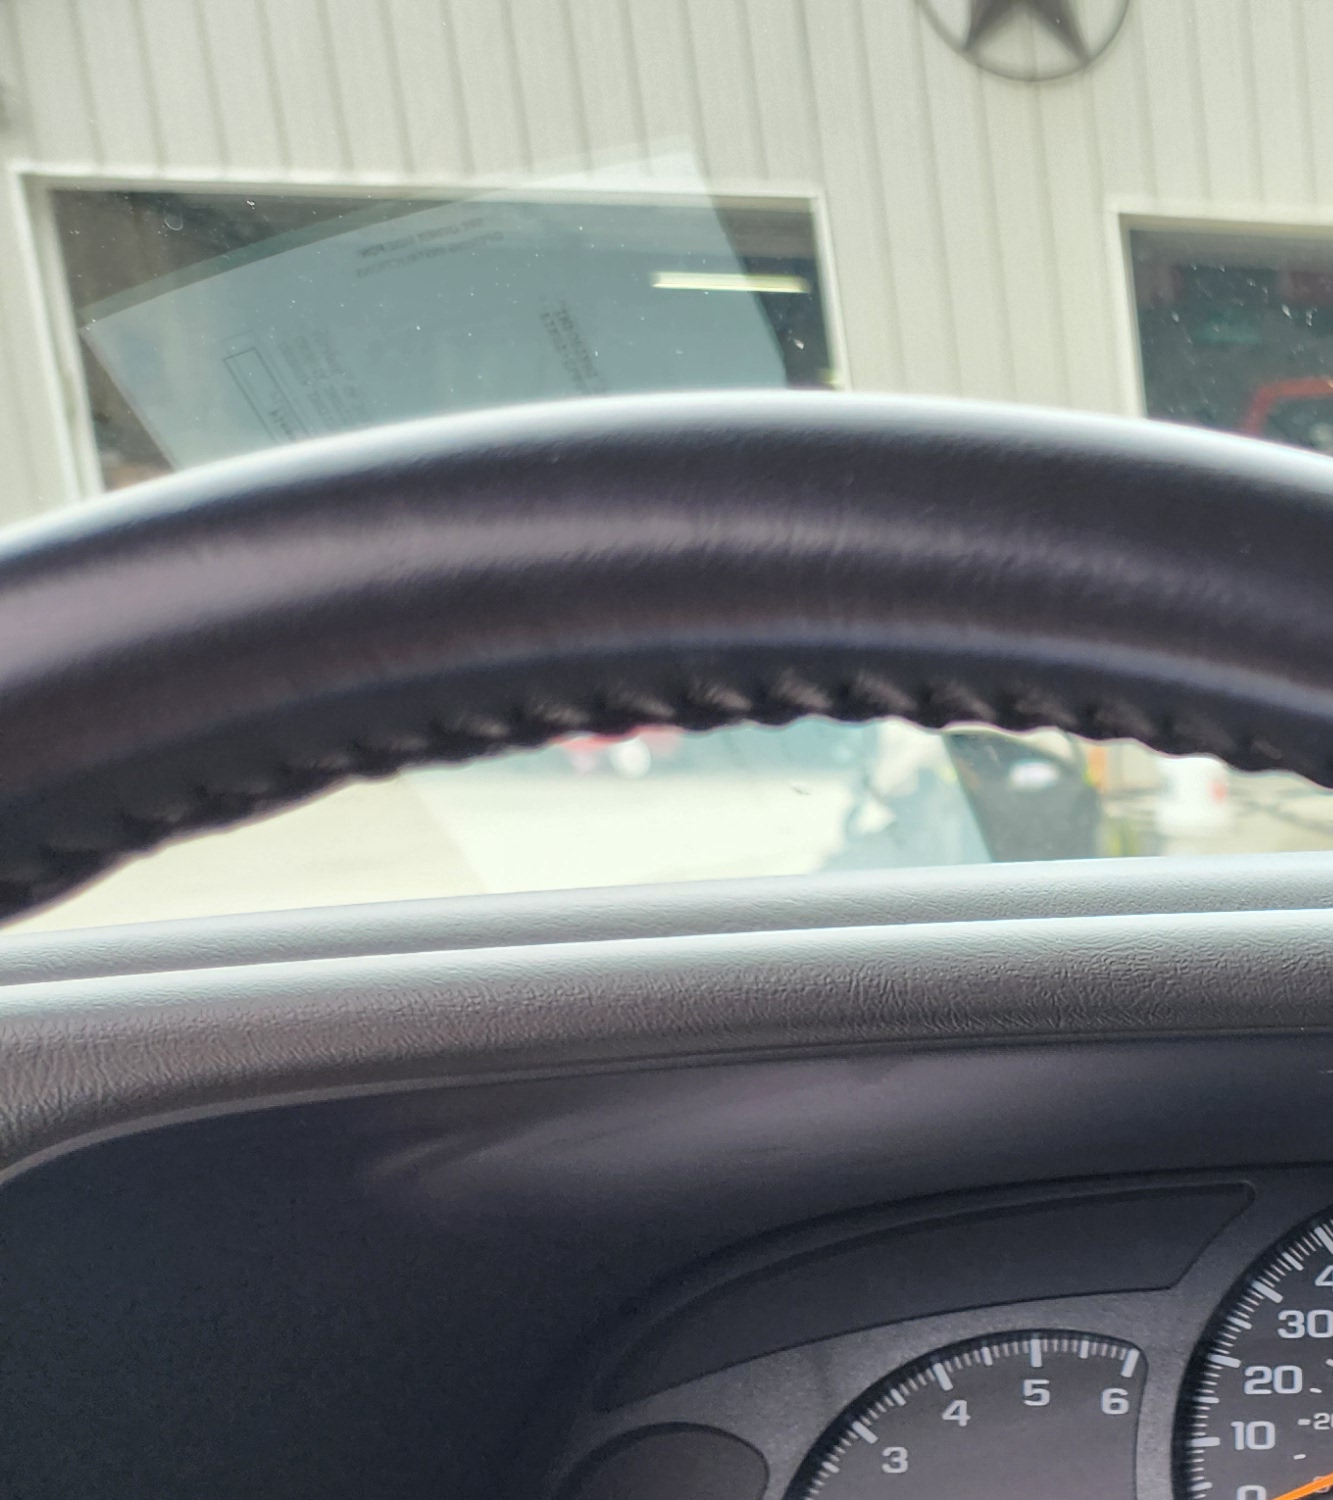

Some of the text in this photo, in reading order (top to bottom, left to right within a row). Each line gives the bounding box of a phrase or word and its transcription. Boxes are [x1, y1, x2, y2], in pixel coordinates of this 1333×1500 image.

[1024, 1380, 1050, 1406] 5
[1245, 1366, 1302, 1394] 20
[942, 1400, 970, 1426] 4
[1102, 1388, 1129, 1414] 6
[1231, 1421, 1275, 1450] 10
[882, 1447, 908, 1473] 3
